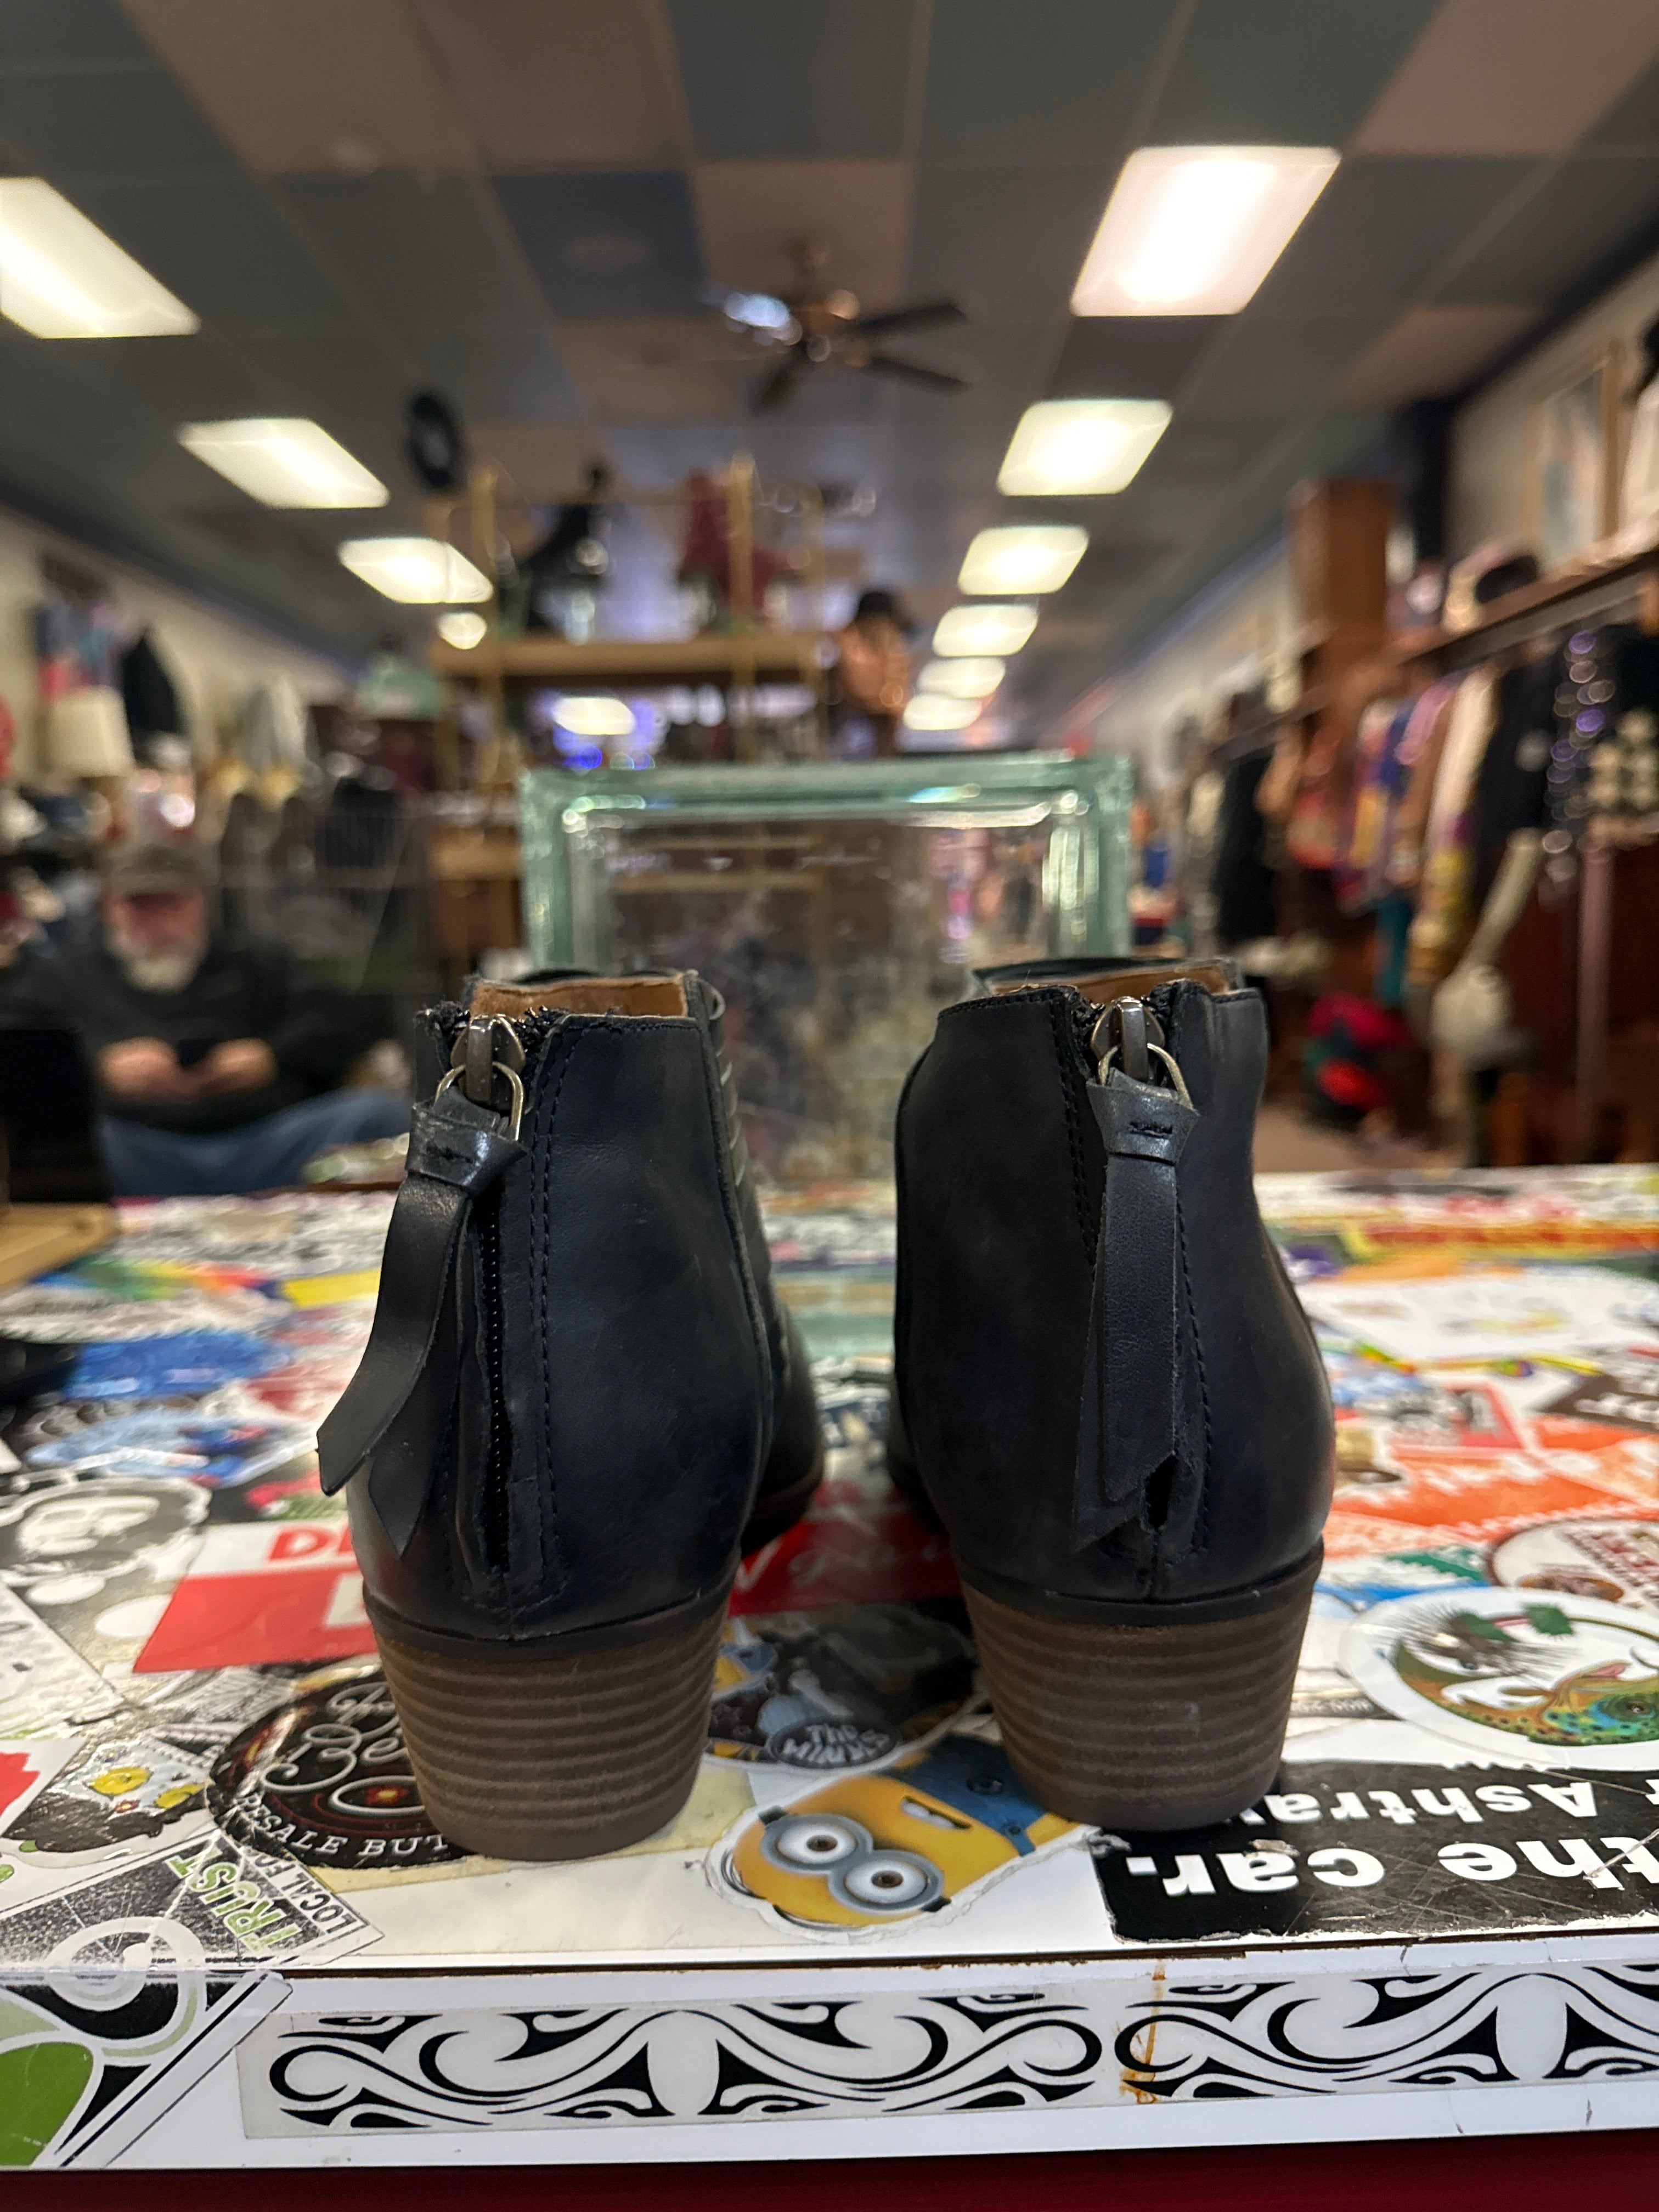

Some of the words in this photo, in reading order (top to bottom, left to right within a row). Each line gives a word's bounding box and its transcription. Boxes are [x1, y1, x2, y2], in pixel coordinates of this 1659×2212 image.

[233, 1793, 348, 1855] RESALE
[1125, 1846, 1385, 1897] car.
[1437, 1836, 1659, 1889] the
[164, 1847, 302, 1956] TRUST
[281, 1872, 358, 1934] LOCAL
